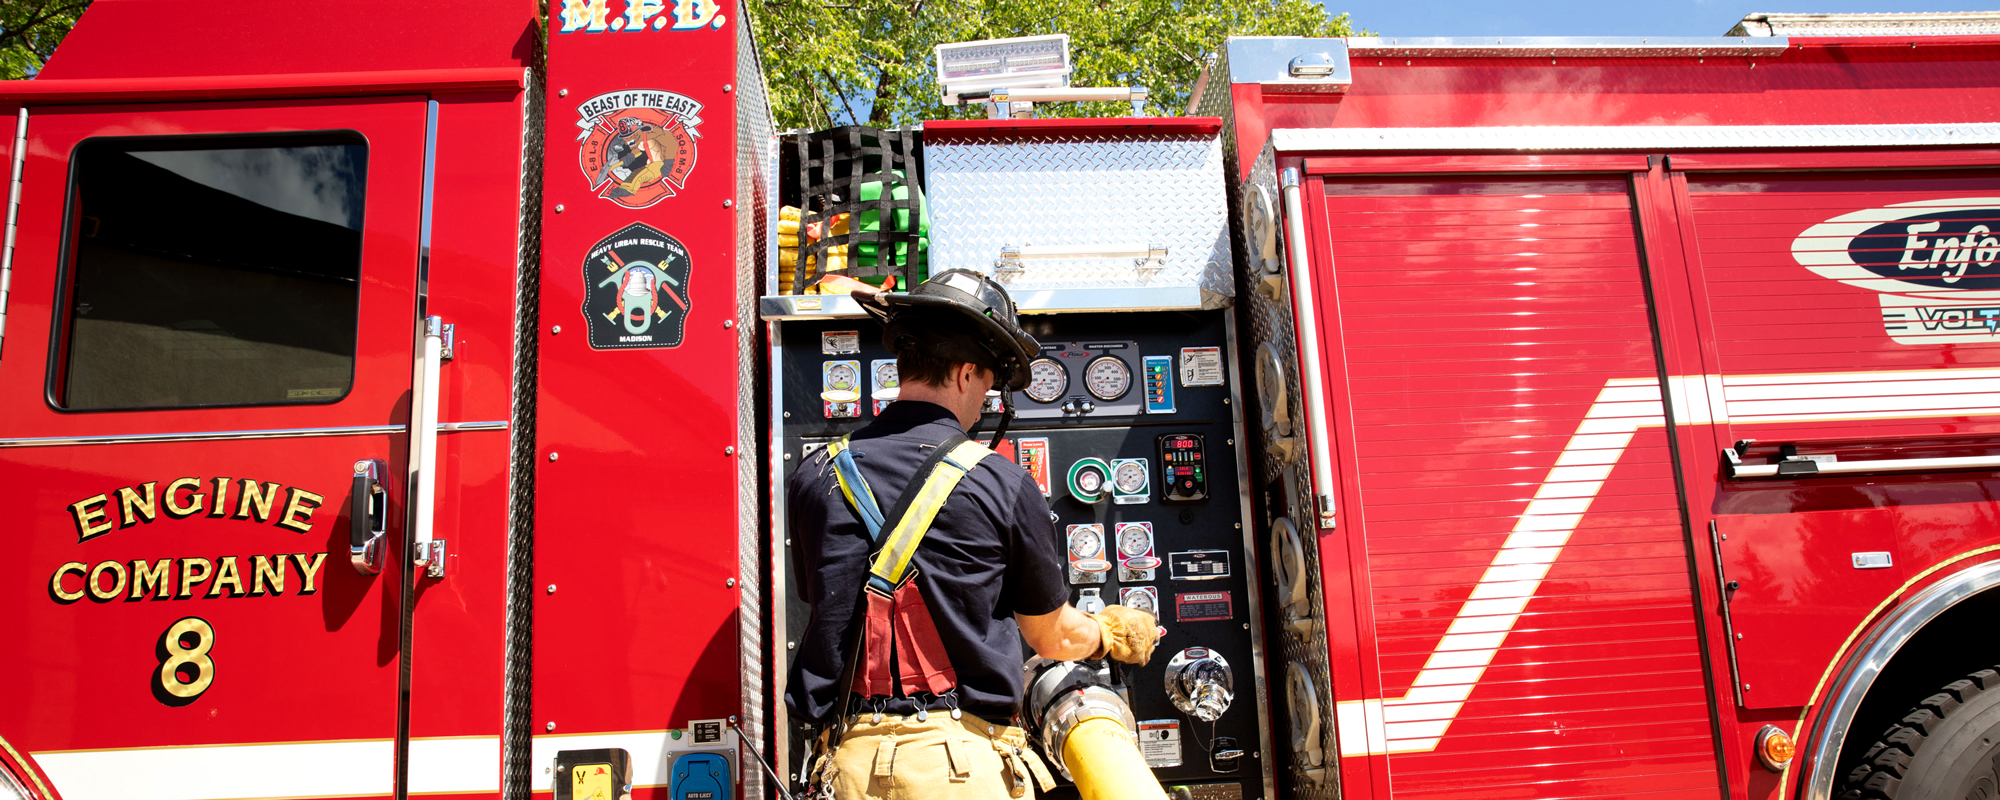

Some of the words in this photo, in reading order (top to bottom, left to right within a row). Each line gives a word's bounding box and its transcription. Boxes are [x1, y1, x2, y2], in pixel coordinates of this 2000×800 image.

[583, 95, 620, 117] BEAST
[624, 94, 638, 106] OF
[642, 94, 664, 107] THE
[666, 96, 696, 115] EAST
[620, 122, 626, 132] 8
[591, 244, 612, 259] HEAVY
[614, 238, 638, 248] URBAN
[640, 238, 664, 248] RESCUE
[666, 243, 684, 256] TEAM
[1177, 440, 1193, 448] 800
[70, 477, 324, 542] ENGINE
[50, 552, 329, 603] COMPANY
[154, 616, 215, 706] 8
